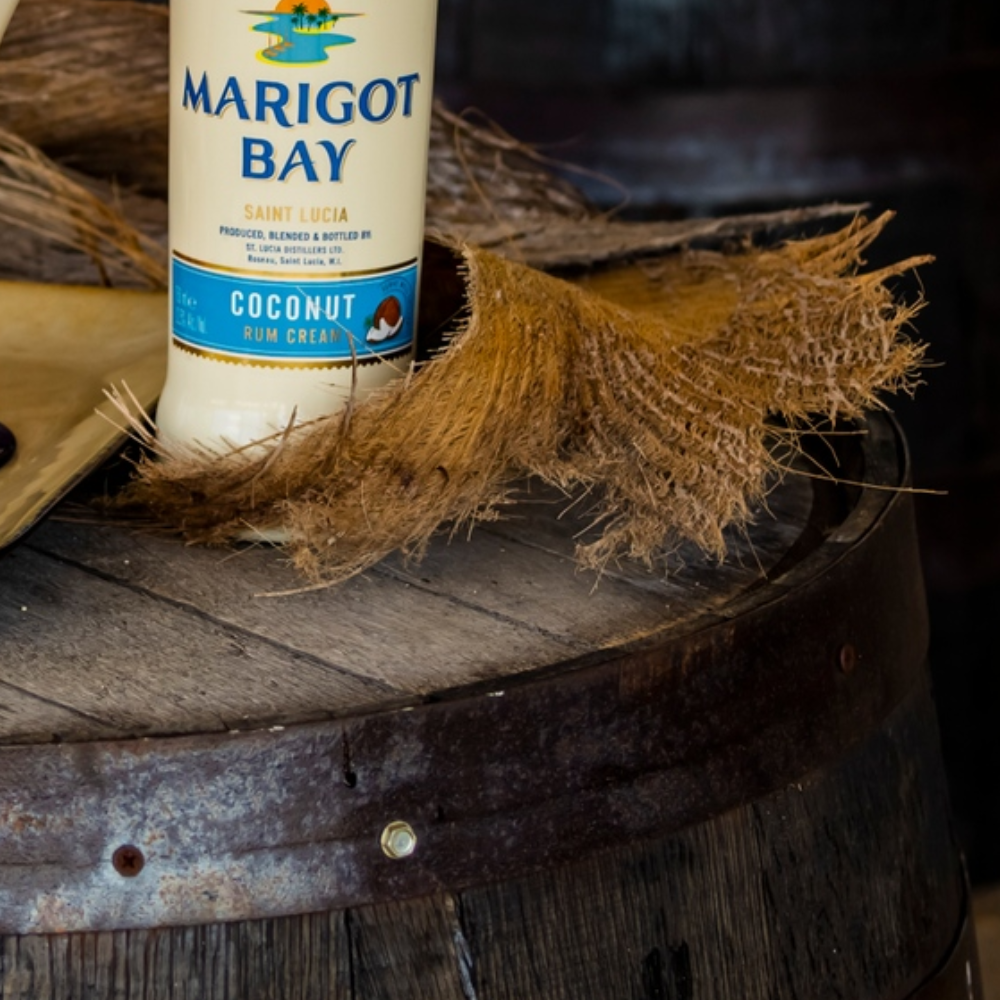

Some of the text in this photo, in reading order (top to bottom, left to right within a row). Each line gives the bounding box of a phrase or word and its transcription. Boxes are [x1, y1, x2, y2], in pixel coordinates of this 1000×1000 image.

[182, 65, 420, 128] MARIGOT
[241, 136, 357, 183] BAY
[244, 203, 349, 223] SAINT LUCIA
[268, 230, 310, 241] BLENDED
[313, 231, 319, 241] &
[322, 230, 359, 241] BOTTLED
[230, 290, 356, 322] COCONUT
[243, 325, 342, 345] RUM CREAM
